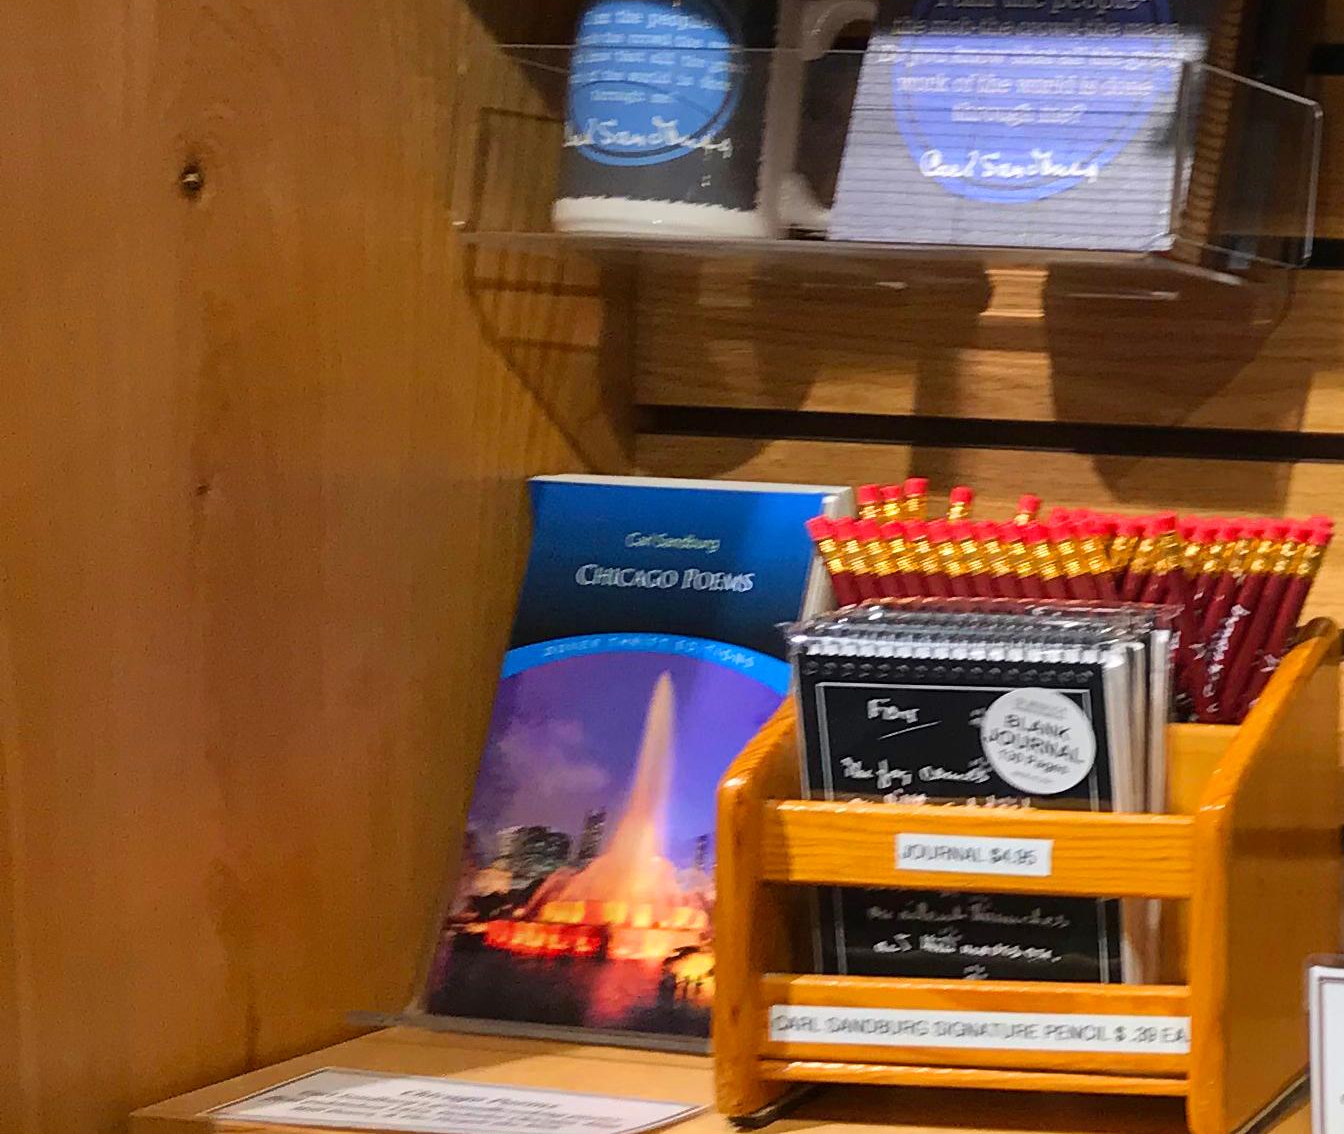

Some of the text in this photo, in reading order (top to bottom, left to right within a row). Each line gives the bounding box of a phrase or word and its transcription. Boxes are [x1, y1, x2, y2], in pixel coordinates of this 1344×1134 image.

[575, 564, 755, 593] CHICAGO POEMS
[902, 844, 986, 862] JOURNAL
